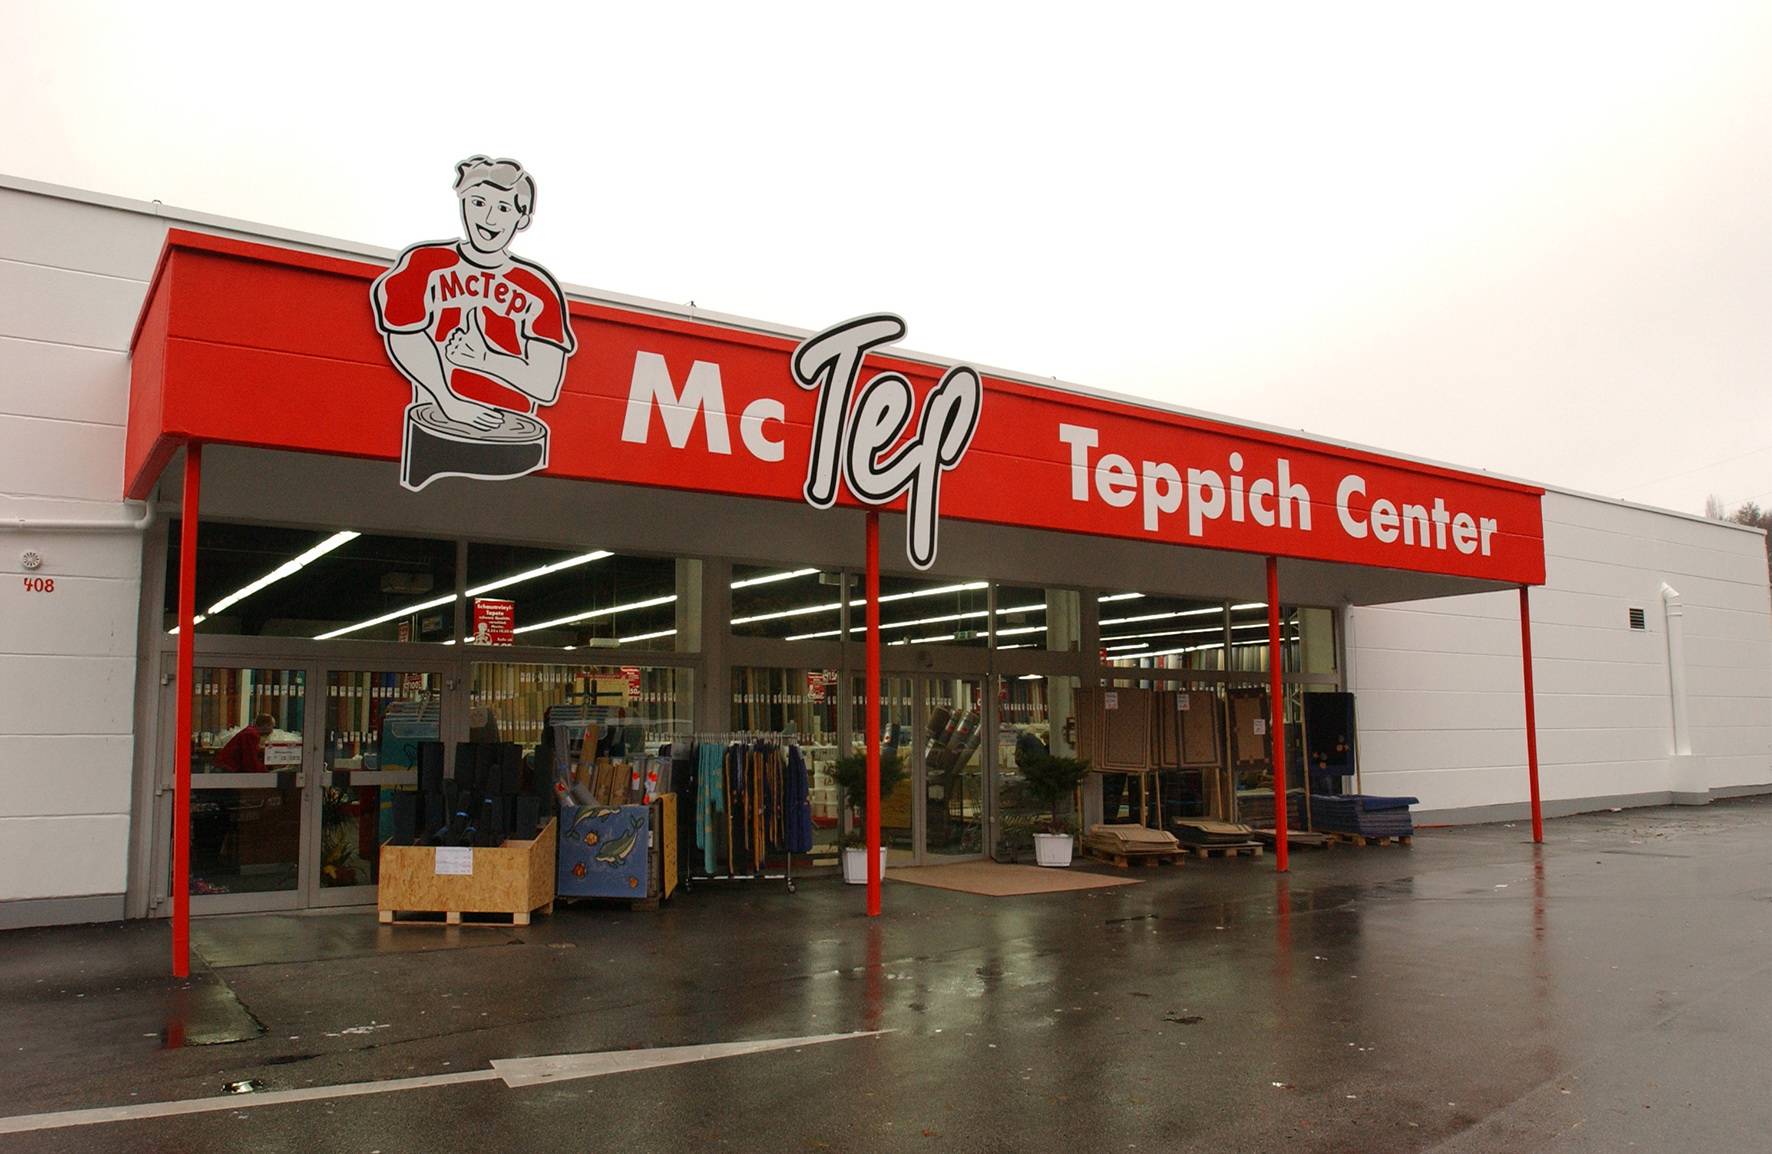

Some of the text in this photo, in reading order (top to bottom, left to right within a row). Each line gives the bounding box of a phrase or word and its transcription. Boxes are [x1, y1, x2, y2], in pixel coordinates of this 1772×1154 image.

[439, 270, 527, 317] McTep
[621, 312, 1498, 571] Mc Tep Teppich Center
[23, 577, 54, 593] 408
